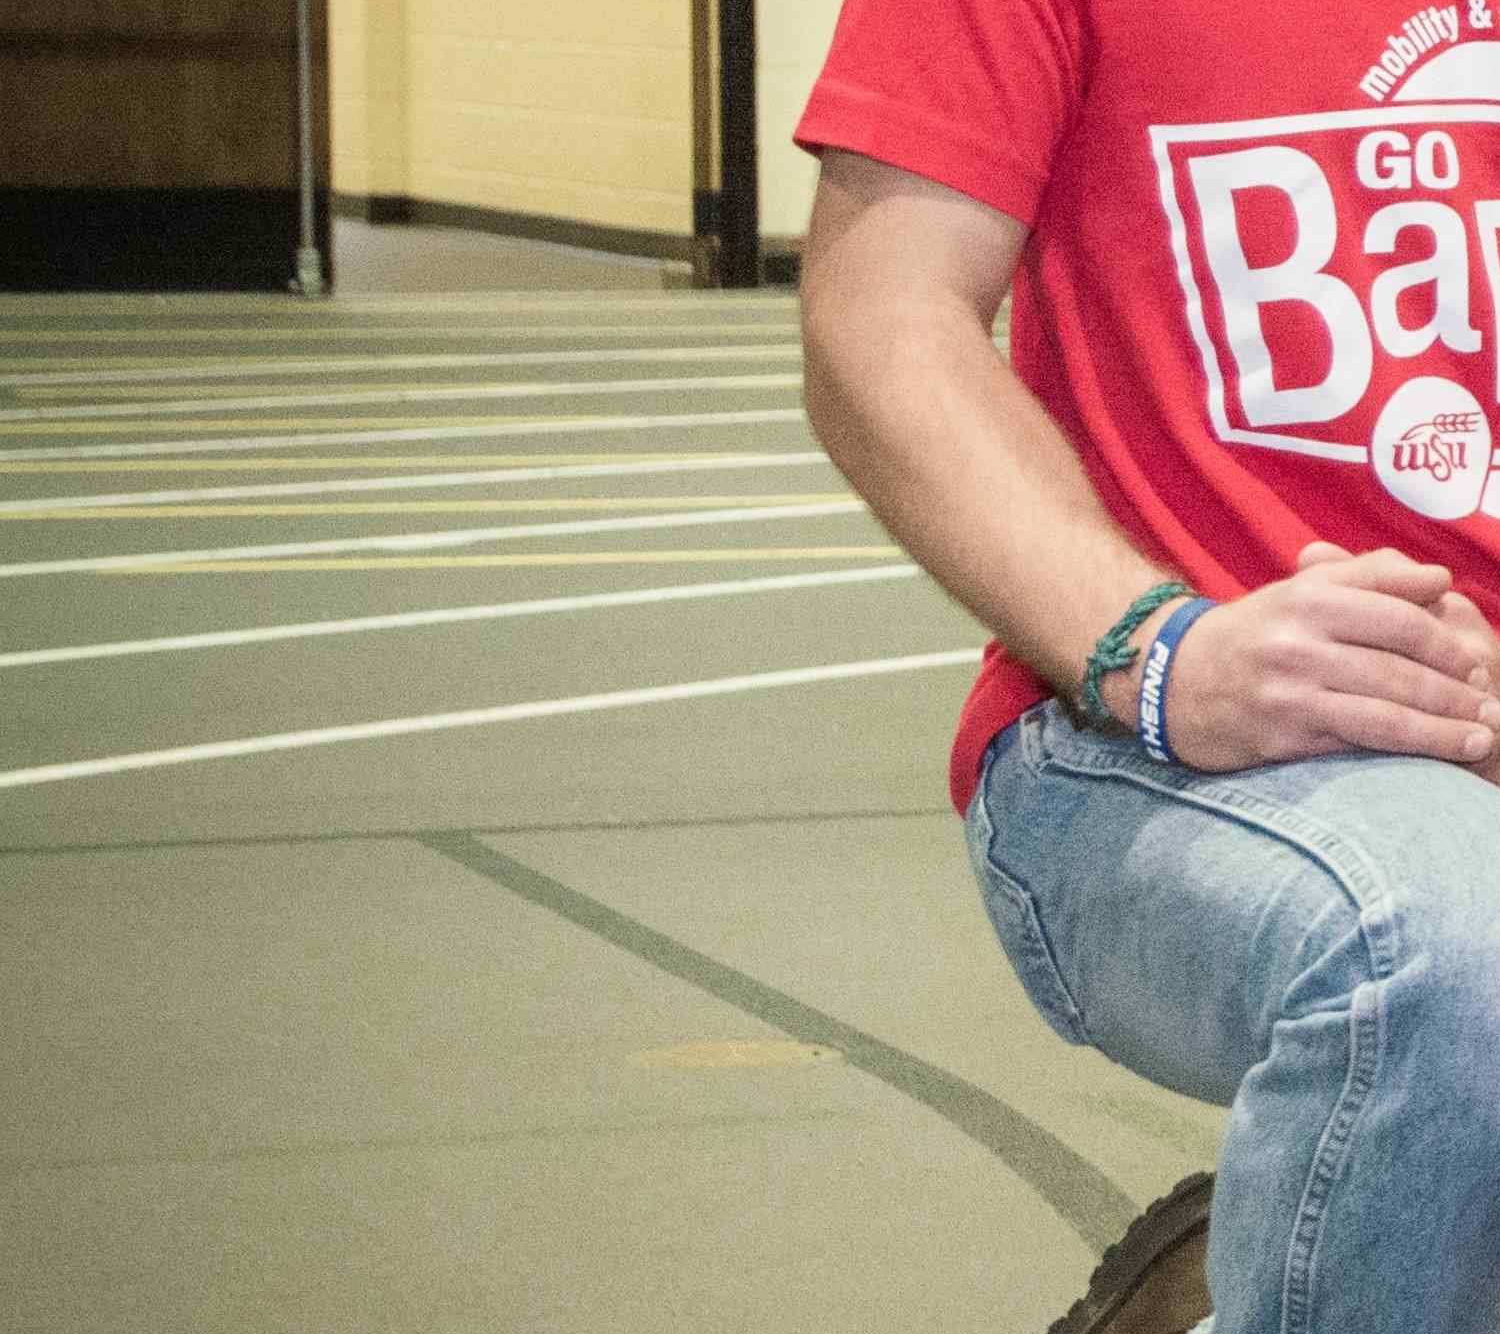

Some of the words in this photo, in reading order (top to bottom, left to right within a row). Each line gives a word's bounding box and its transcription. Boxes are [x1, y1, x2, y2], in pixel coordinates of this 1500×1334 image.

[1359, 2, 1459, 101] mobility
[1355, 130, 1460, 190] GO
[1141, 640, 1170, 746] FINISH
